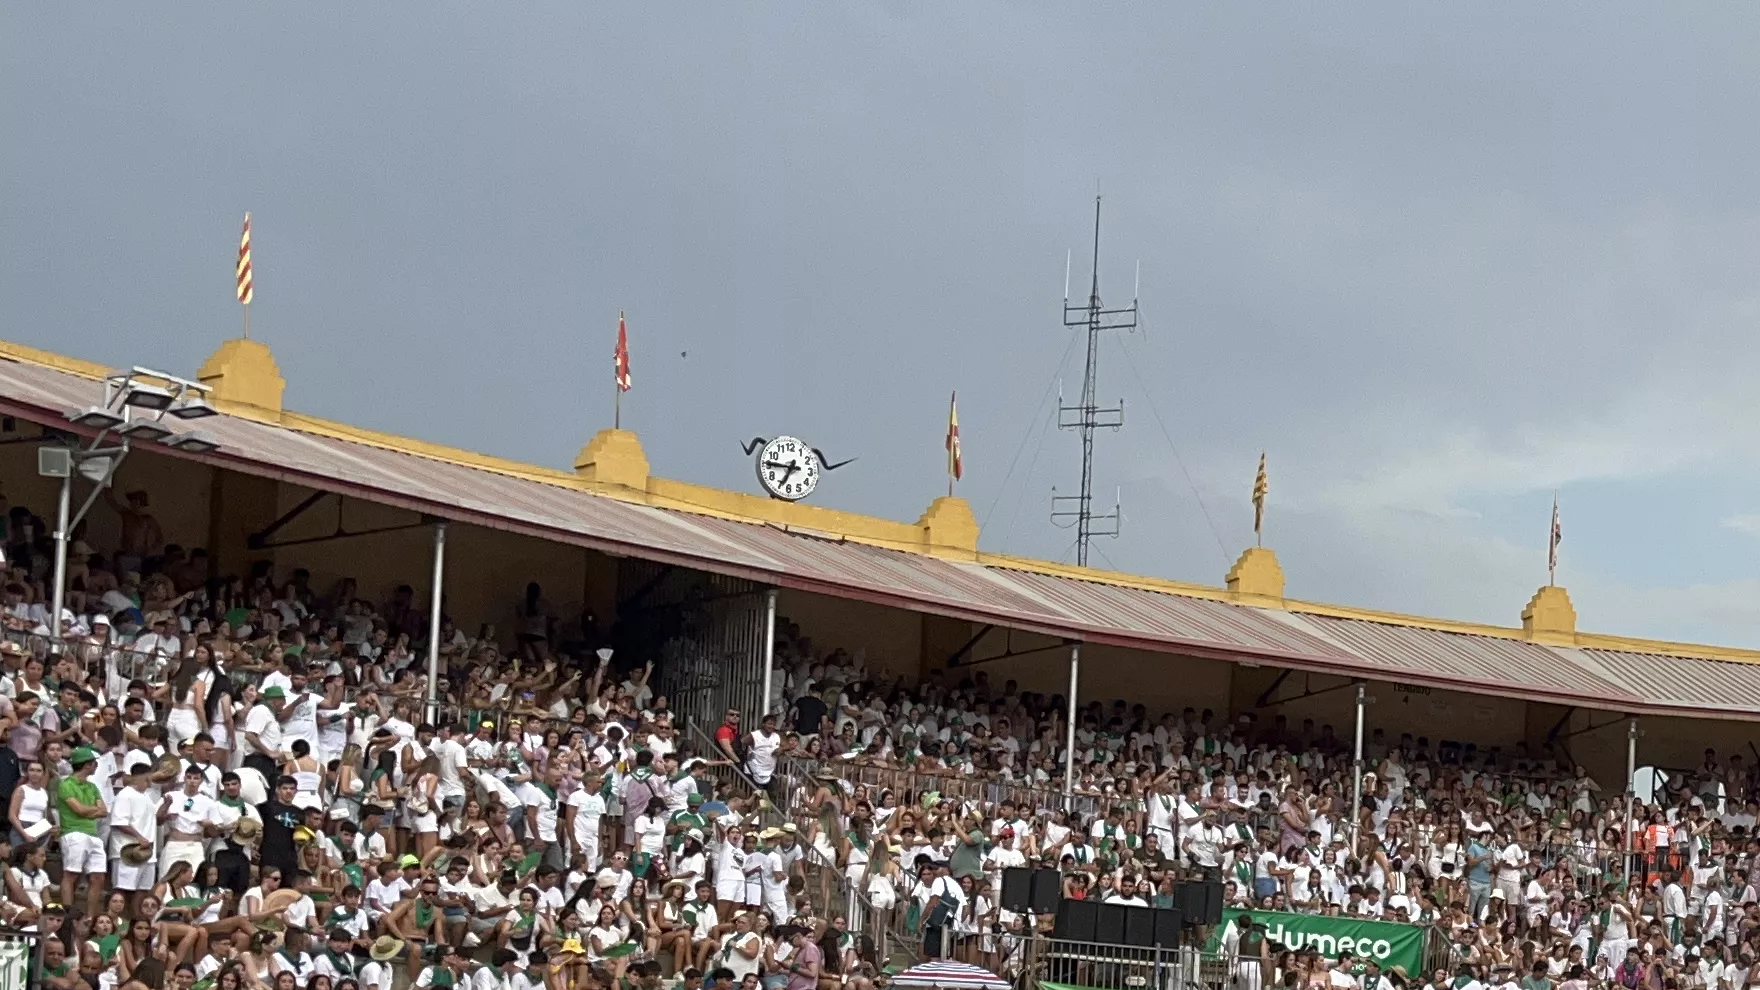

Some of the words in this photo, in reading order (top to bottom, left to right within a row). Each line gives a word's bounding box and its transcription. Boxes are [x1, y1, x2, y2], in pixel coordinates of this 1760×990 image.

[777, 444, 785, 453] 11
[786, 443, 795, 452] 12
[769, 451, 778, 460] 10
[805, 456, 811, 465] 2
[769, 471, 775, 480] 8
[808, 467, 813, 477] 3
[804, 478, 809, 486] 4
[786, 484, 792, 493] 6
[796, 484, 802, 492] 5
[1265, 923, 1391, 960] Humeco
